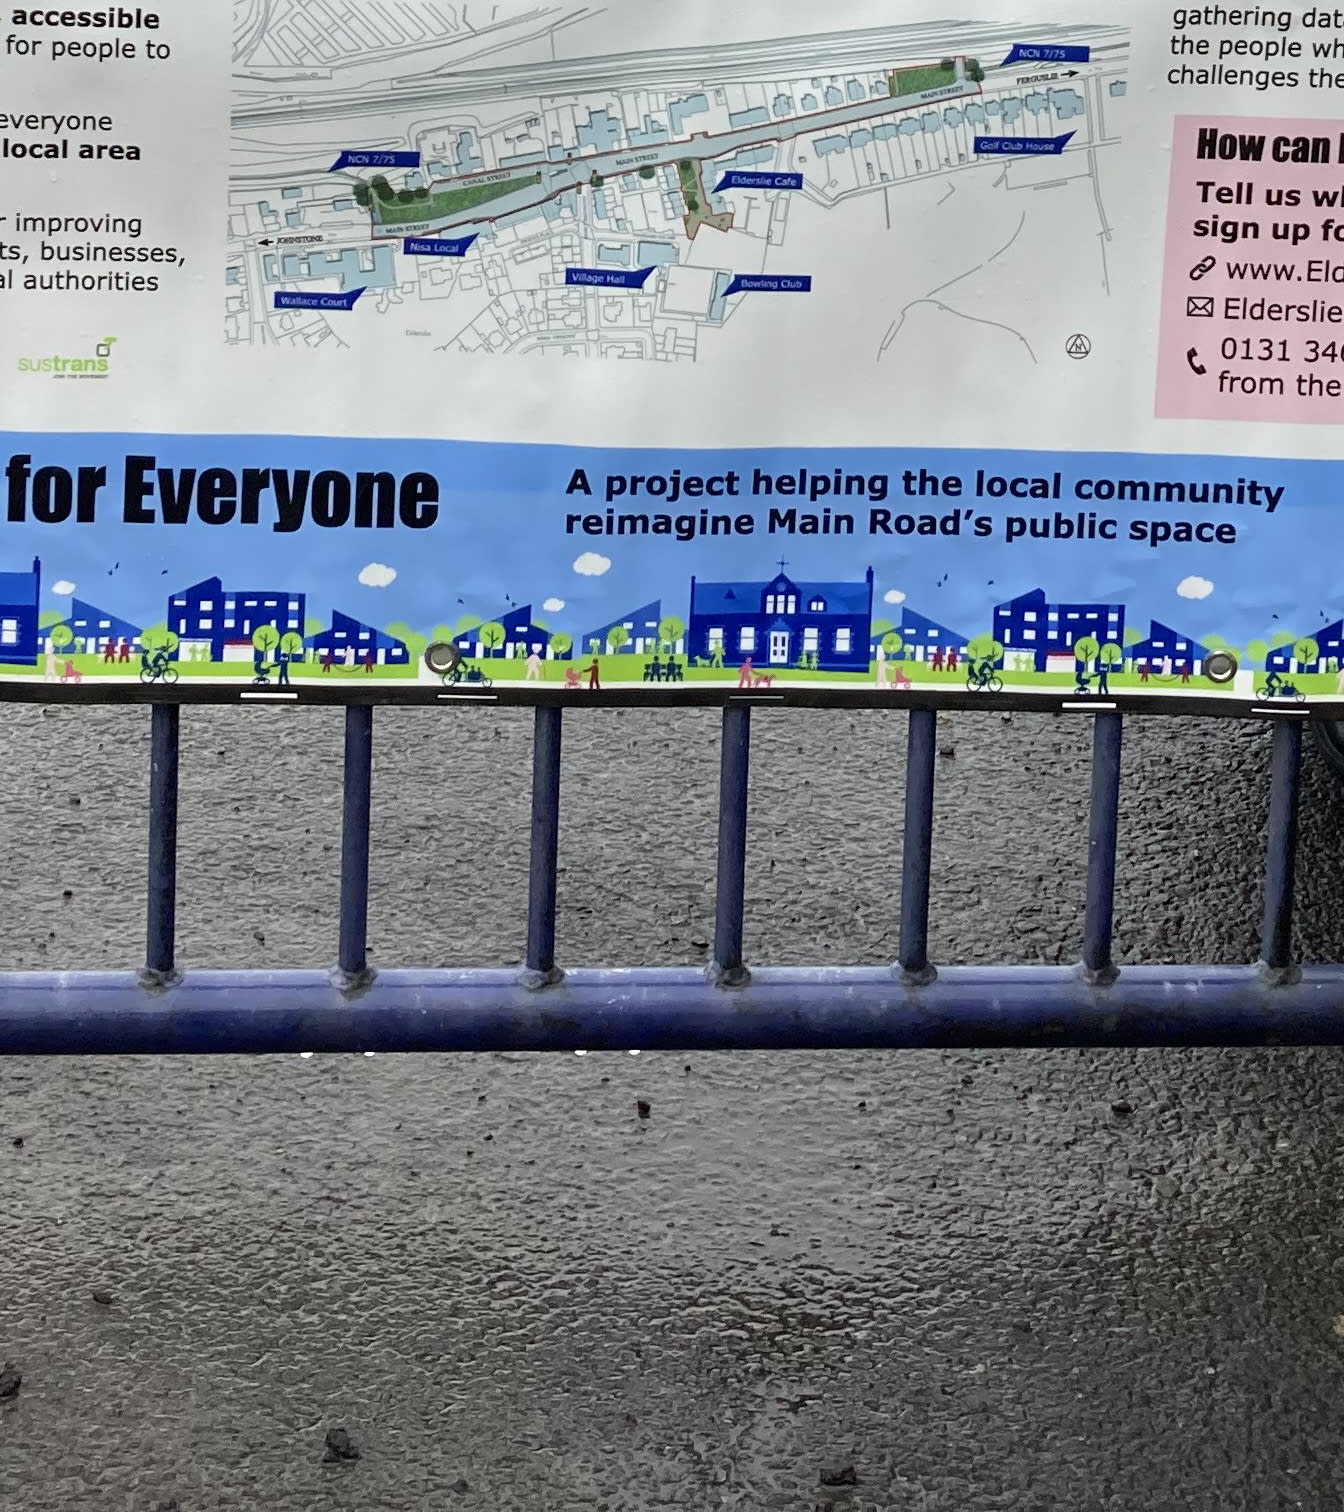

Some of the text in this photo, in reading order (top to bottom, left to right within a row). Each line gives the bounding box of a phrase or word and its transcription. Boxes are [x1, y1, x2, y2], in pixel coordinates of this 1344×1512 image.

[1018, 48, 1066, 59] NCN 7/75
[980, 140, 1056, 151] Golf Club House
[1196, 127, 1267, 162] How
[1271, 135, 1331, 164] can
[347, 154, 396, 165] NCN 7/75
[731, 175, 797, 186] Elderslie Cafe
[15, 212, 142, 239] improving
[409, 242, 459, 254] Nisa Local
[571, 273, 625, 284] Village Hall
[740, 279, 803, 289] Bowling Club
[280, 295, 348, 308] Wallace Court
[1221, 336, 1291, 362] 0131
[17, 355, 109, 372] sustrans
[4, 453, 107, 524] for
[122, 454, 440, 533] Everyone
[564, 467, 1286, 513] A project helping the local community
[565, 507, 1237, 548] reimagine Main Road's public space
